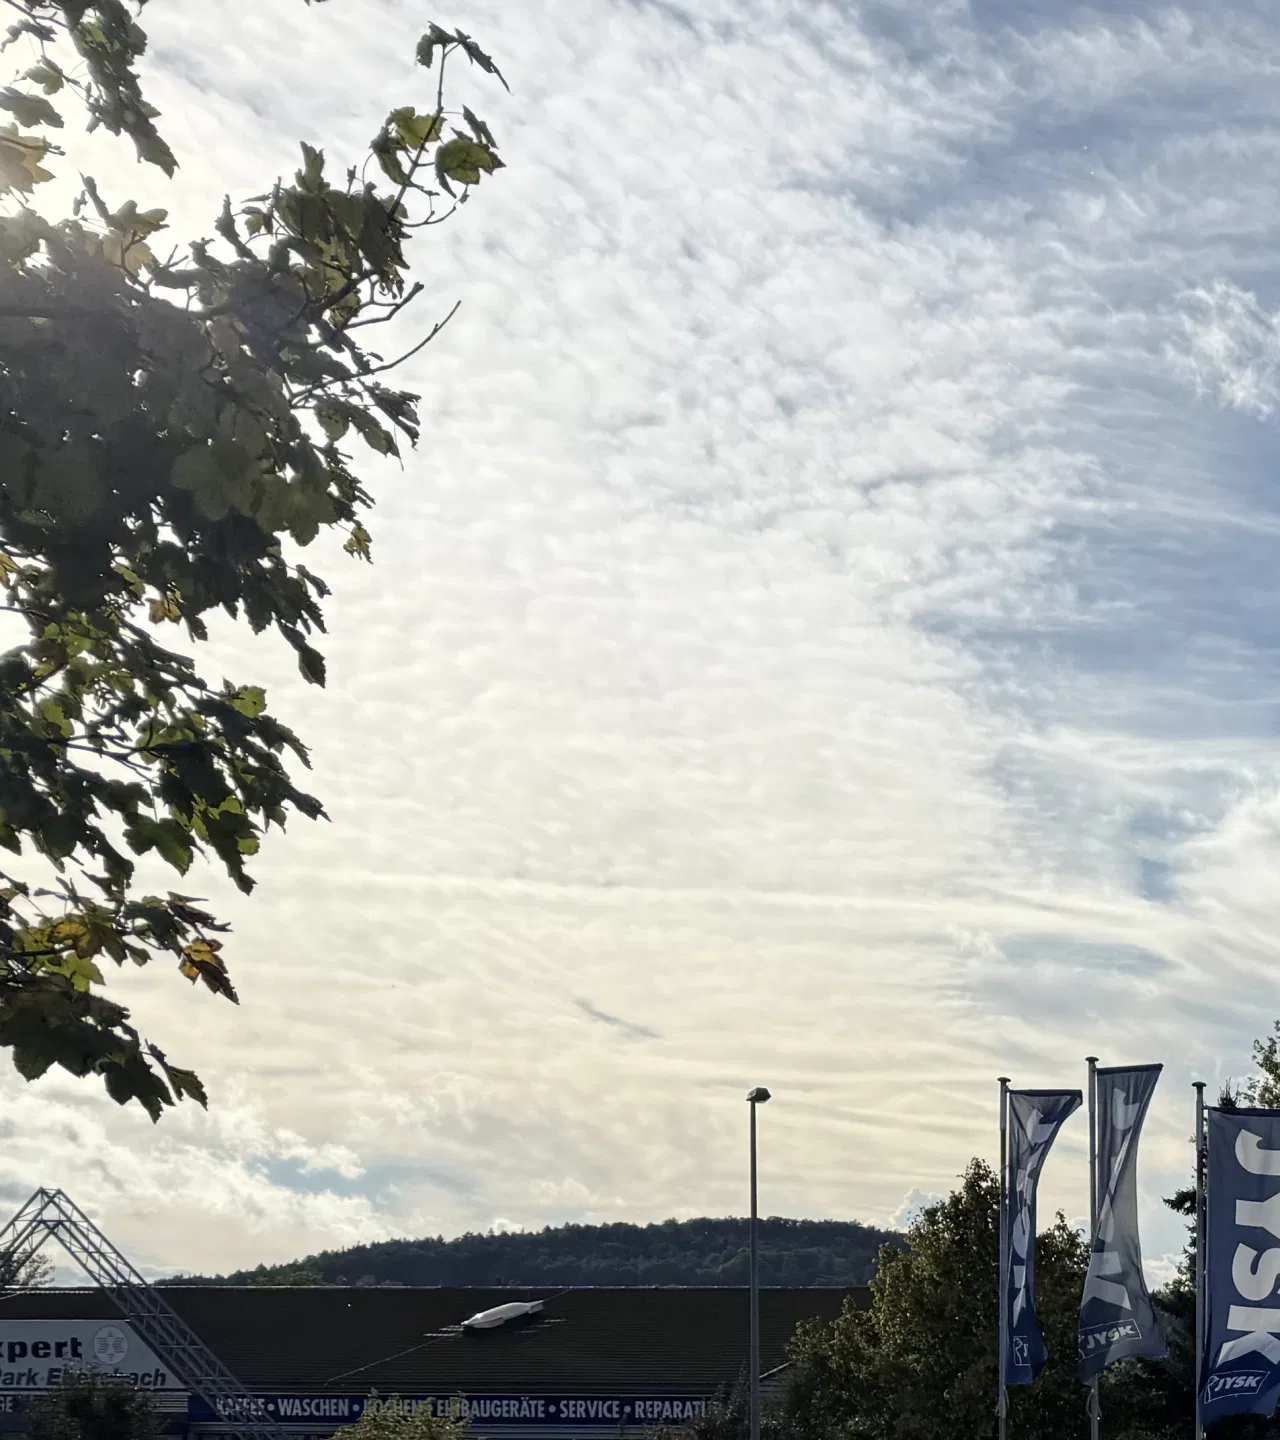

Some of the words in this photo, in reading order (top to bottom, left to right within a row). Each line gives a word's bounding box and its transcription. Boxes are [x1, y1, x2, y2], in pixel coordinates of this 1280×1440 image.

[1086, 1319, 1136, 1350] JYSK
[0, 1337, 82, 1363] pert
[0, 1367, 39, 1386] ark
[1217, 1375, 1261, 1391] JYSK
[277, 1398, 349, 1416] WASCHEN
[559, 1399, 620, 1418] SERVICE
